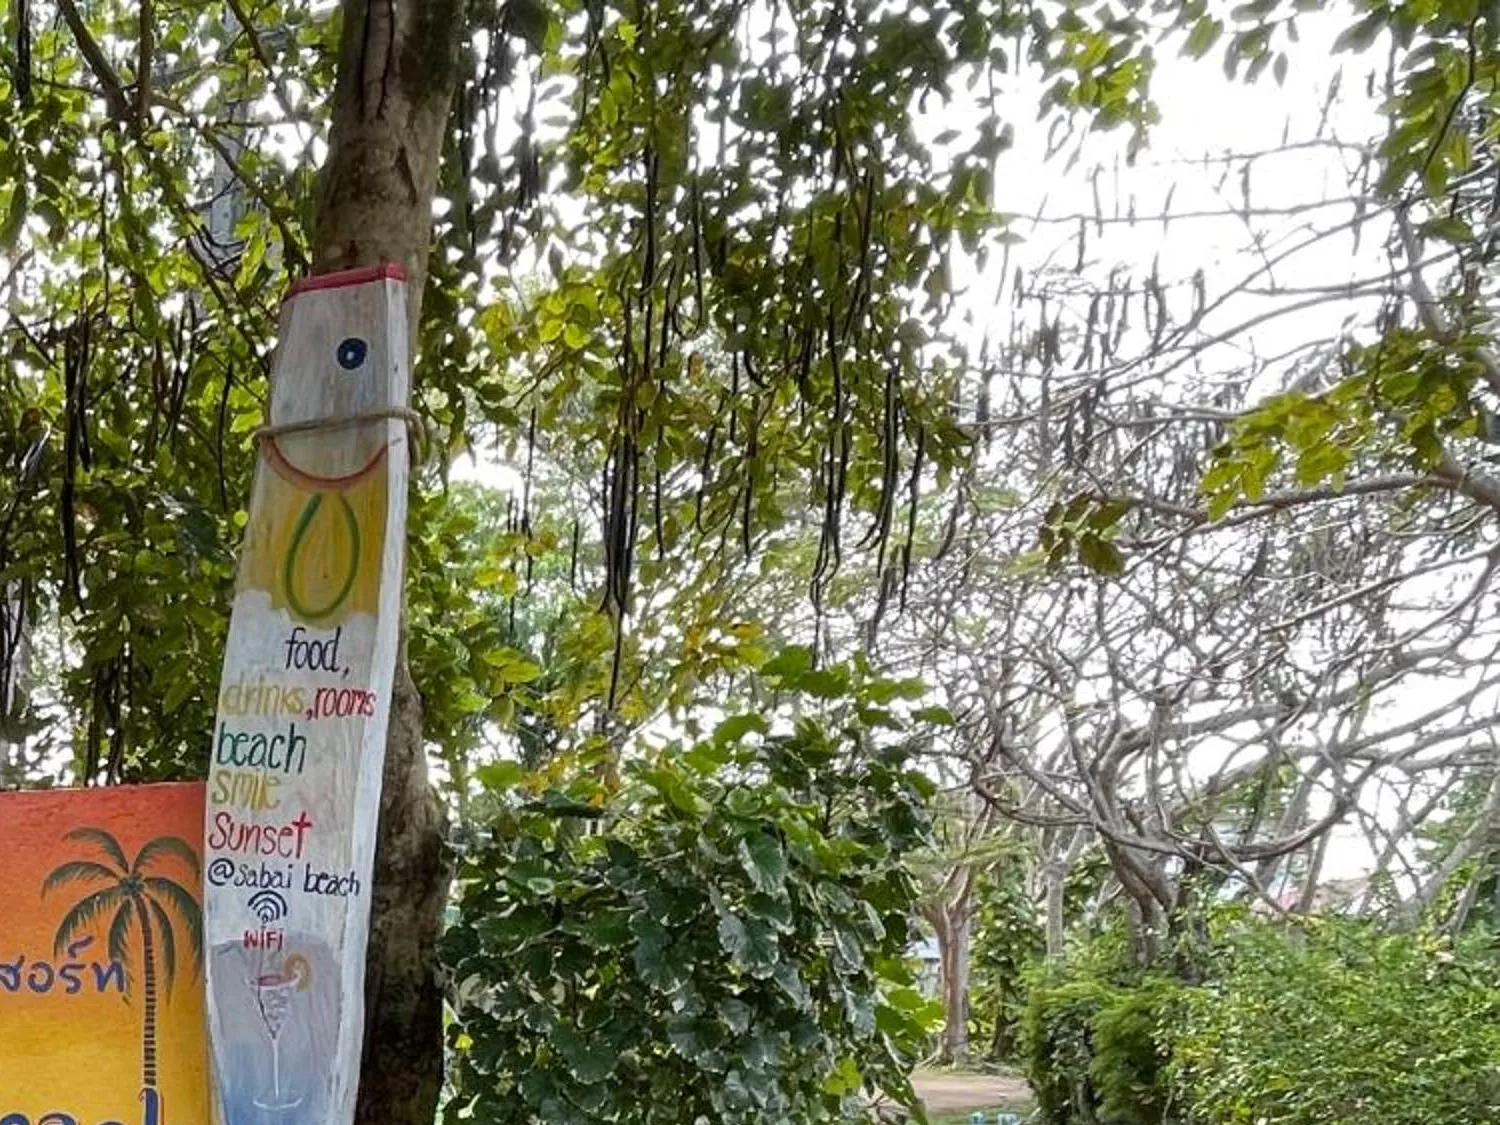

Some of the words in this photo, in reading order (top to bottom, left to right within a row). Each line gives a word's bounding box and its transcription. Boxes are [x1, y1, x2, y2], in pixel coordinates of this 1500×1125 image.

[285, 626, 350, 679] food,
[215, 721, 307, 773] beach
[208, 857, 293, 889] @sabai
[303, 863, 360, 897] beach
